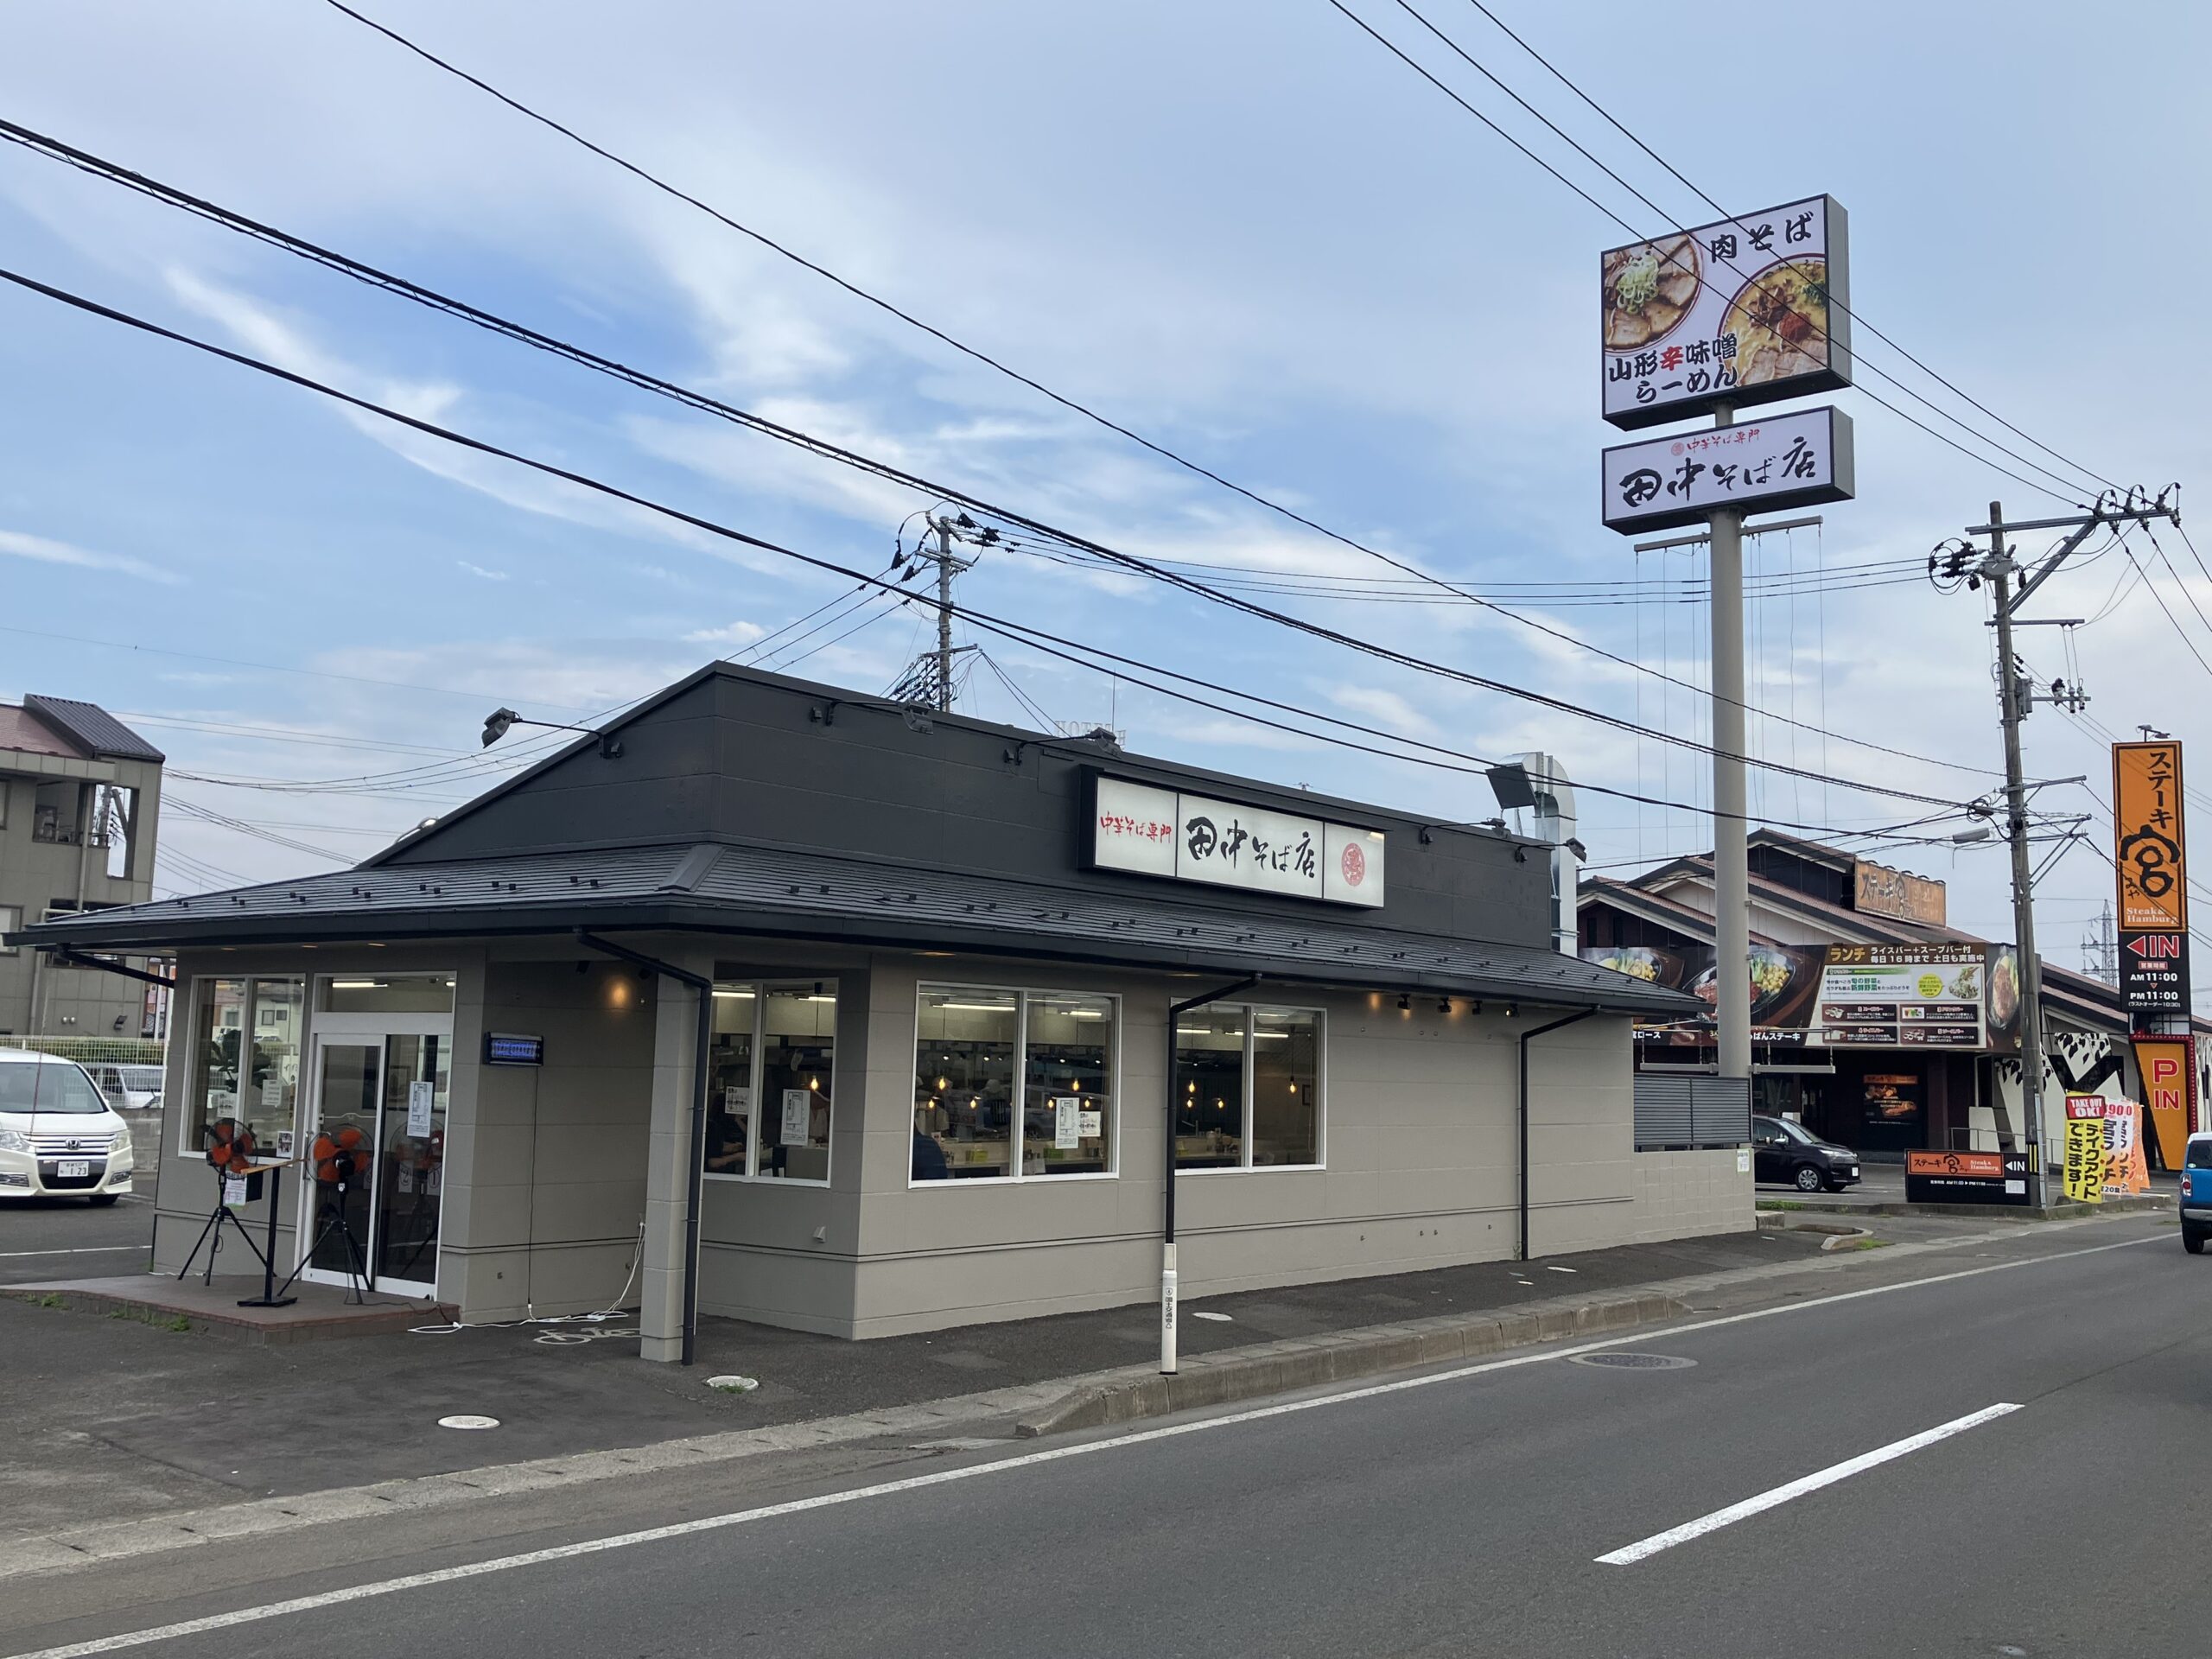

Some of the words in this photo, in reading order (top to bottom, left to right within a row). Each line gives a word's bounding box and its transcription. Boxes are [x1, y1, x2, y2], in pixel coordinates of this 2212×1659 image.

[1710, 210, 1815, 263] 肉そば
[1608, 334, 1738, 382] 山形辛味噌
[1636, 363, 1738, 404] らーめん
[1618, 436, 1818, 507] 田中そば店
[2146, 751, 2174, 830] ステーキ
[1100, 810, 1172, 843] 中華そば専門
[1185, 816, 1315, 879] 田中そば店
[1830, 946, 1866, 962] ランチ
[2149, 935, 2180, 958] IN
[2152, 1058, 2179, 1084] P
[2070, 1099, 2088, 1108] TAKE
[2089, 1098, 2102, 1108] OUT
[2075, 1107, 2101, 1117] OK!
[2153, 1089, 2181, 1110] IN
[1914, 1159, 1942, 1167] ステーキ
[2013, 1161, 2025, 1172] IN
[2068, 1122, 2084, 1197] できます!
[2083, 1123, 2100, 1199] テイクアウト
